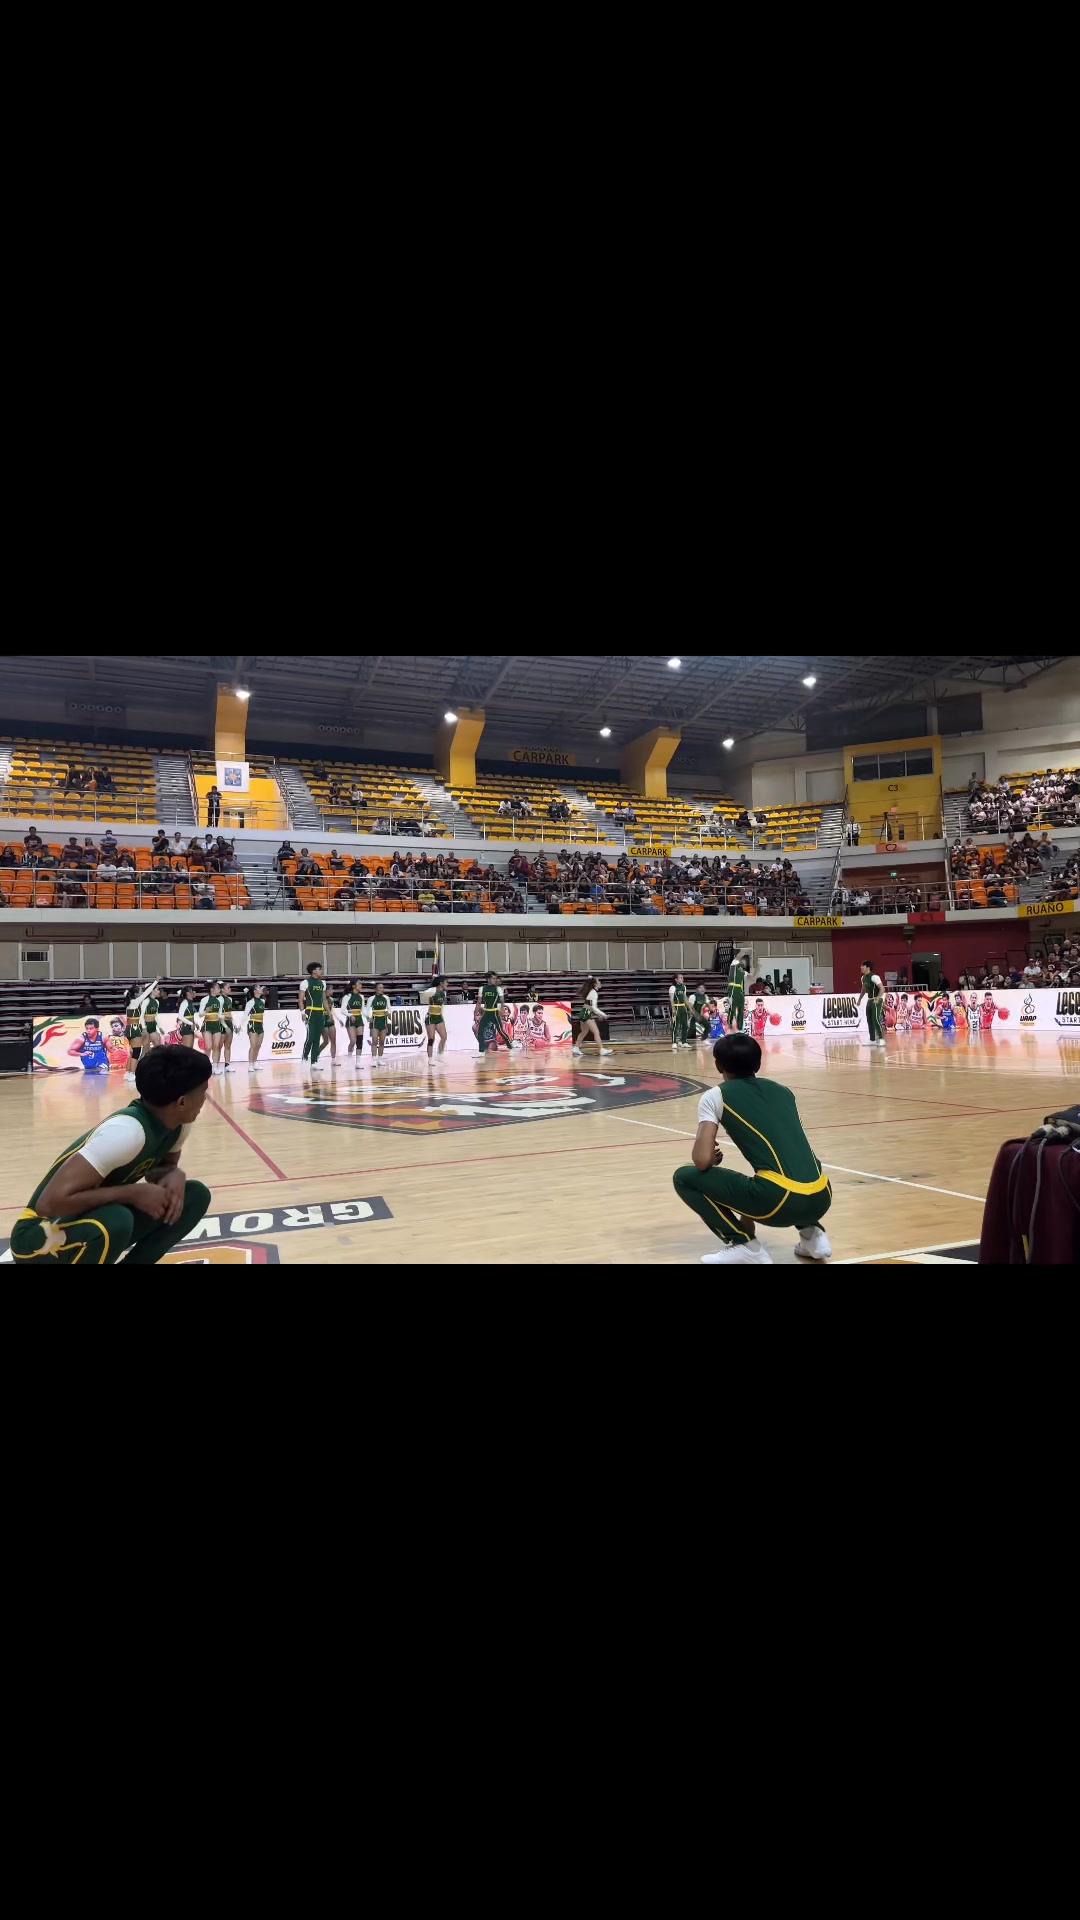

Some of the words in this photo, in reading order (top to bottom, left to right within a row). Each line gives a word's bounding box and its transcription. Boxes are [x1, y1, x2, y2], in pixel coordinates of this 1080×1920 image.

[513, 750, 569, 765] CARPARK
[887, 784, 899, 792] C3
[630, 847, 668, 856] CARPARK
[885, 843, 898, 852] C2
[1026, 902, 1064, 915] RUAÑO
[797, 917, 838, 926] CARPARK
[1056, 991, 1080, 1016] LEGE
[385, 1037, 399, 1045] ART
[401, 1036, 419, 1044] HERE
[271, 1041, 296, 1050] UAAP
